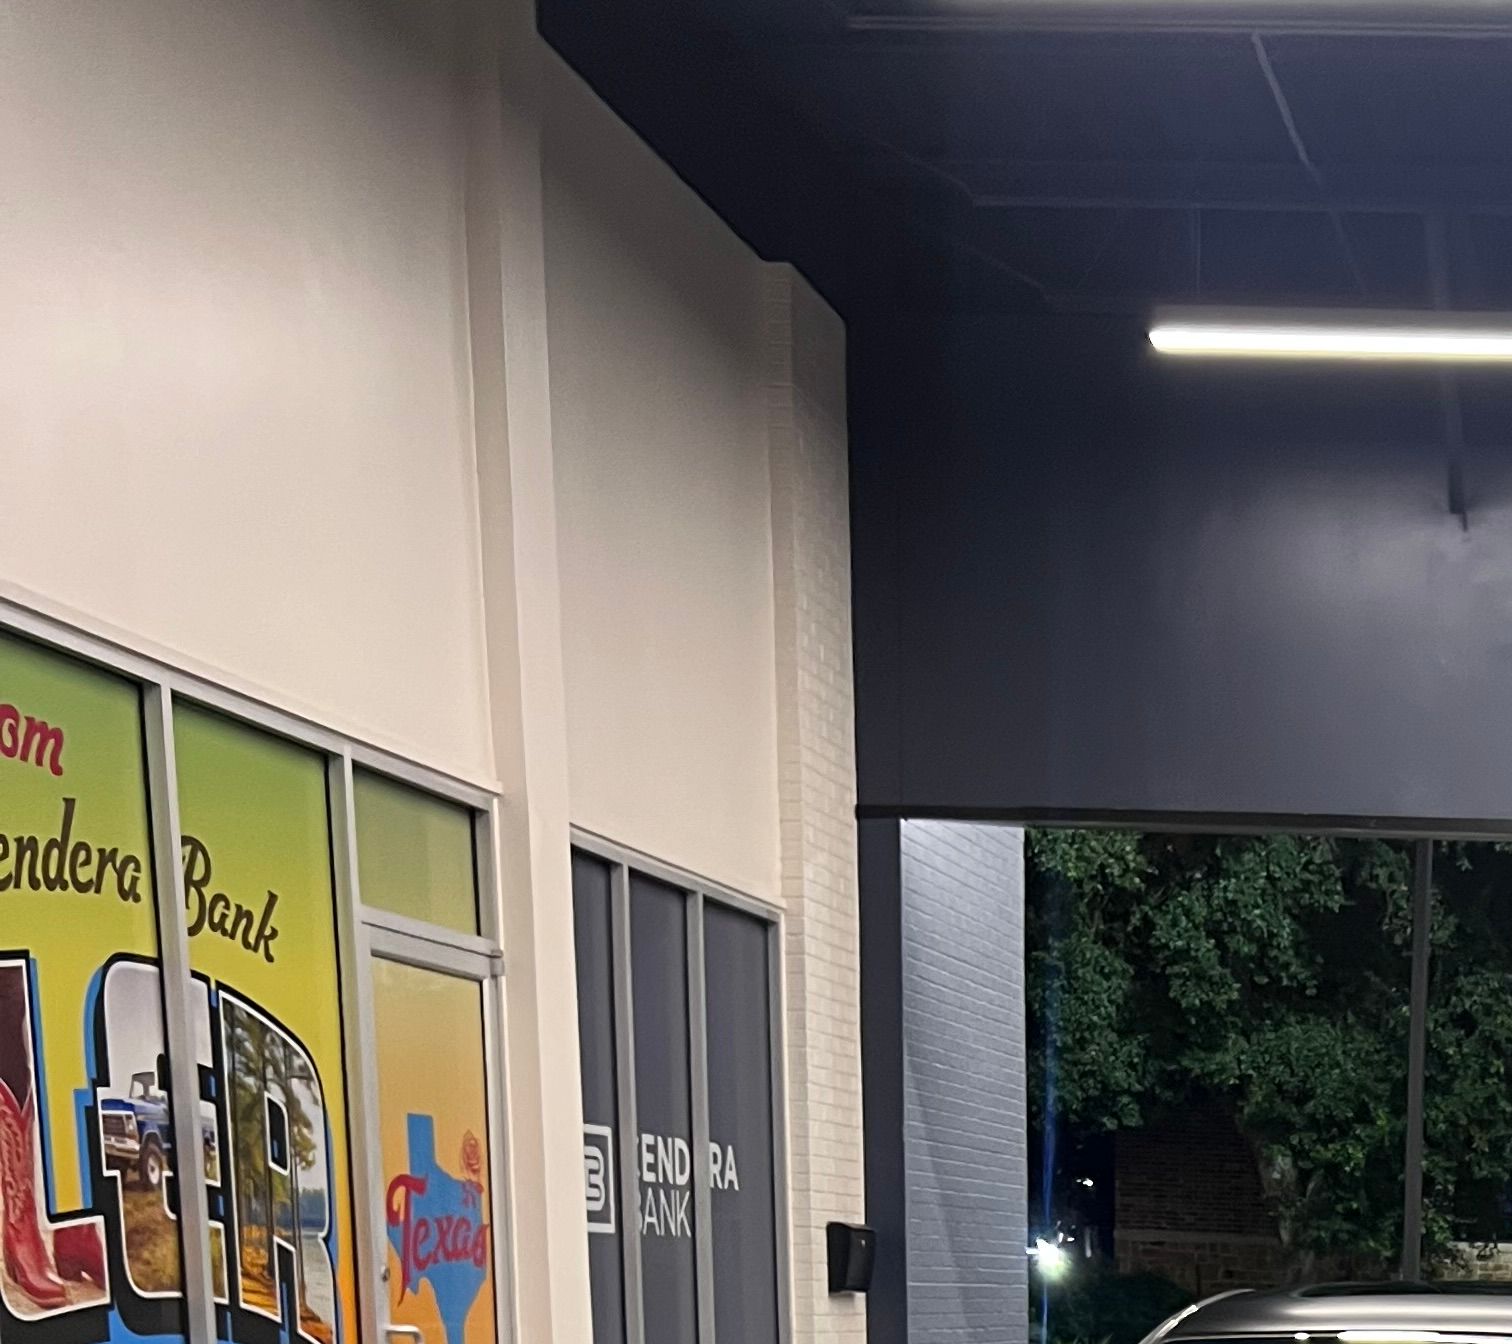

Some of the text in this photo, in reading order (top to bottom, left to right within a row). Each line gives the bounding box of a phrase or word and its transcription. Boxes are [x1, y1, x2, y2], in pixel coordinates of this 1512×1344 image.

[181, 835, 279, 963] Bank
[386, 1173, 490, 1307] Texas
[636, 1186, 692, 1238] ANK
